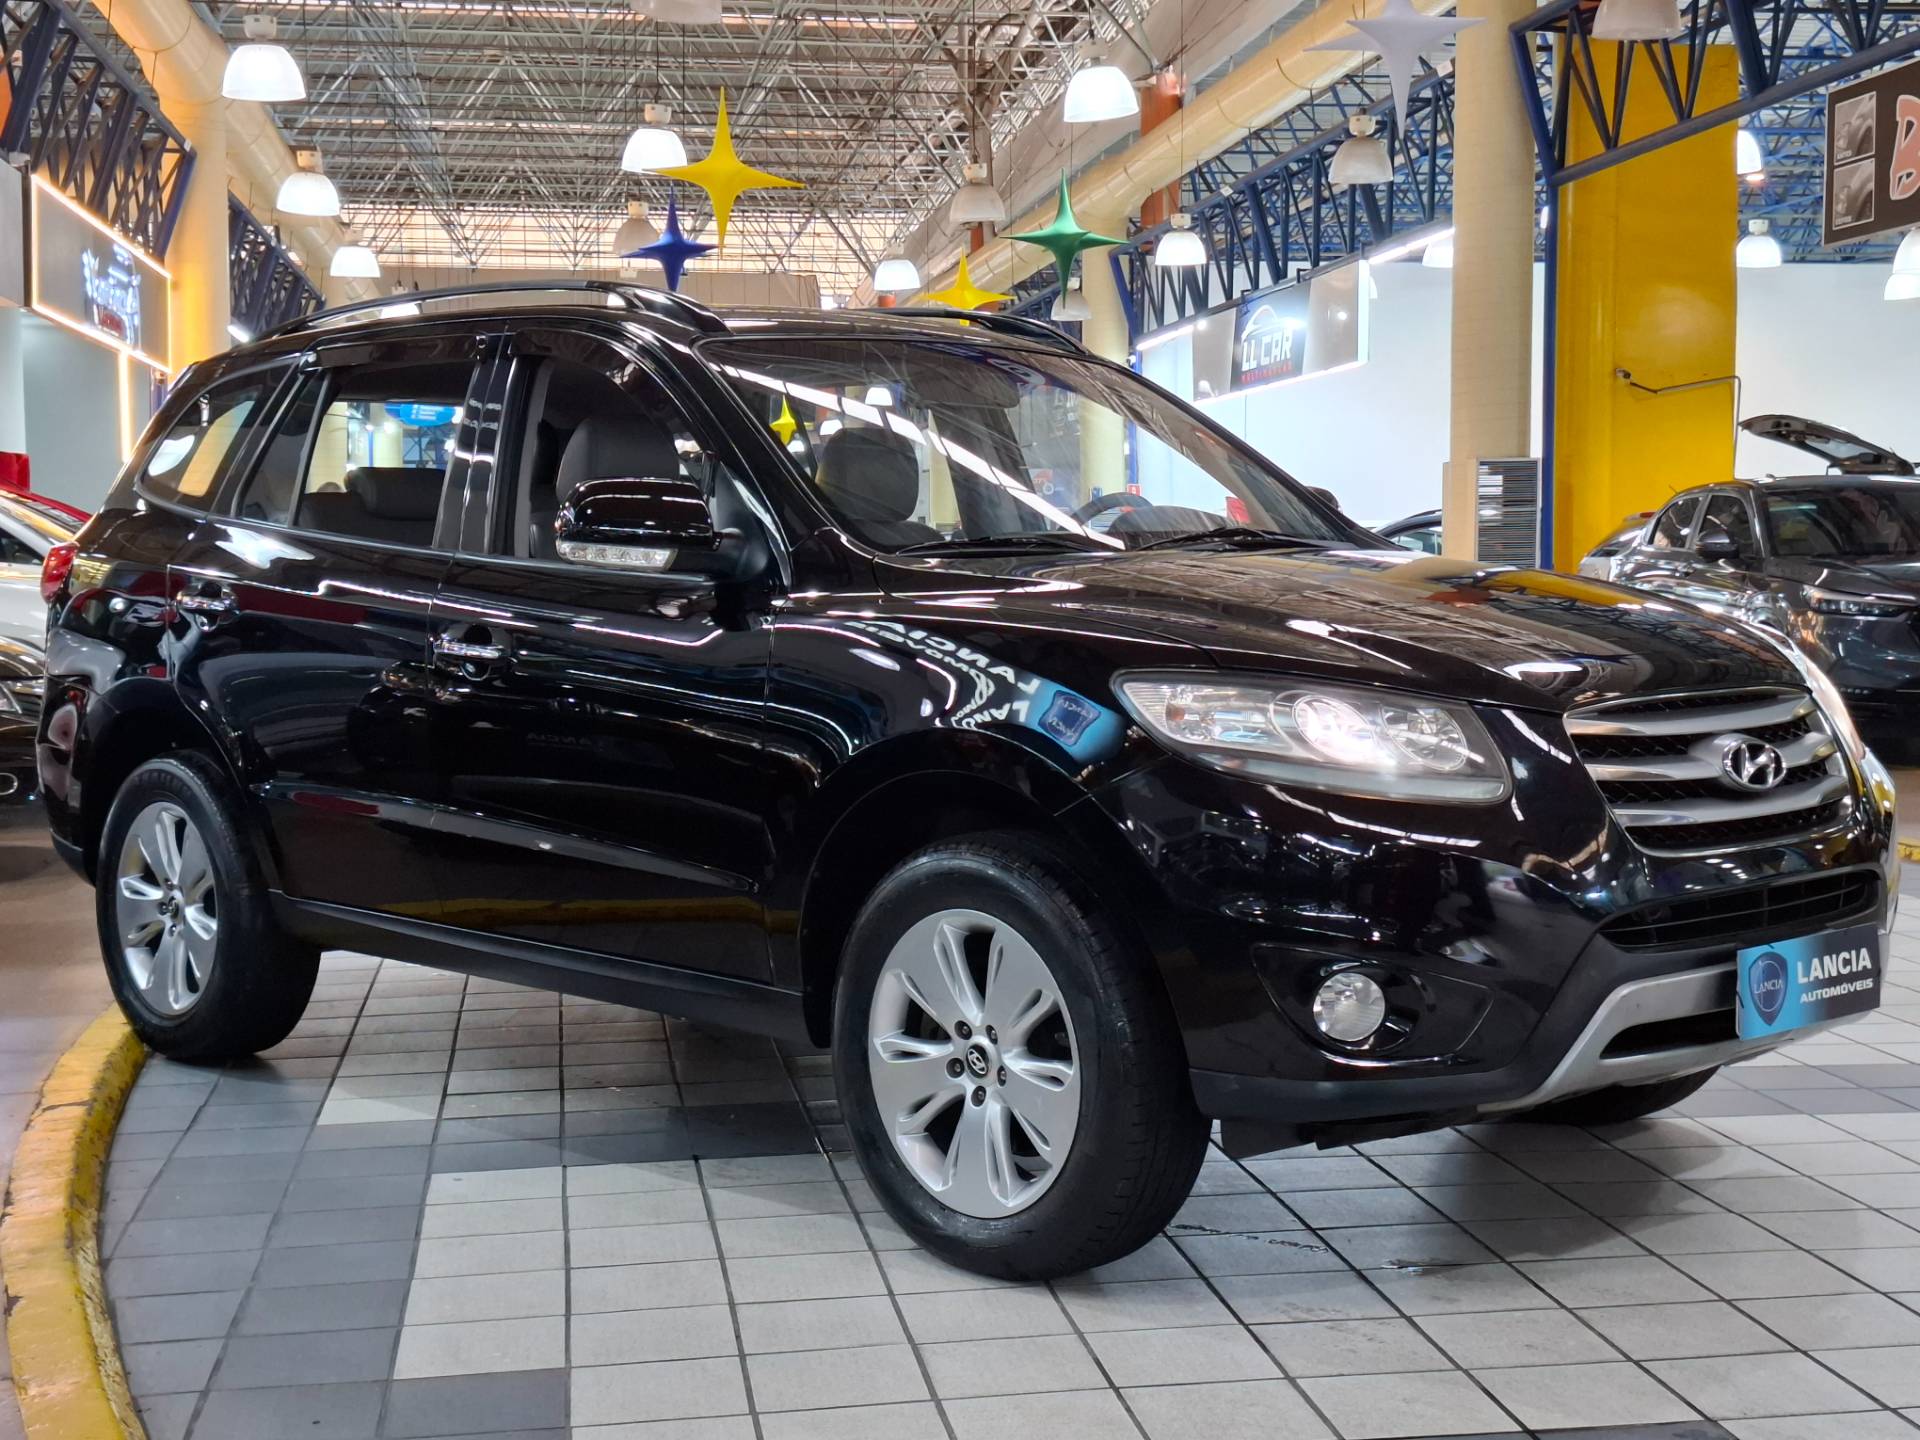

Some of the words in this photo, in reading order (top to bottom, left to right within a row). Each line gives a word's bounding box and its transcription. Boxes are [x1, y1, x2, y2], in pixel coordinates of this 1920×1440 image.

[1261, 329, 1293, 366] CAR
[1797, 947, 1872, 984] LANCIA
[1754, 979, 1784, 994] LANCIA
[1800, 978, 1874, 1003] AUTOMÓVEIS
